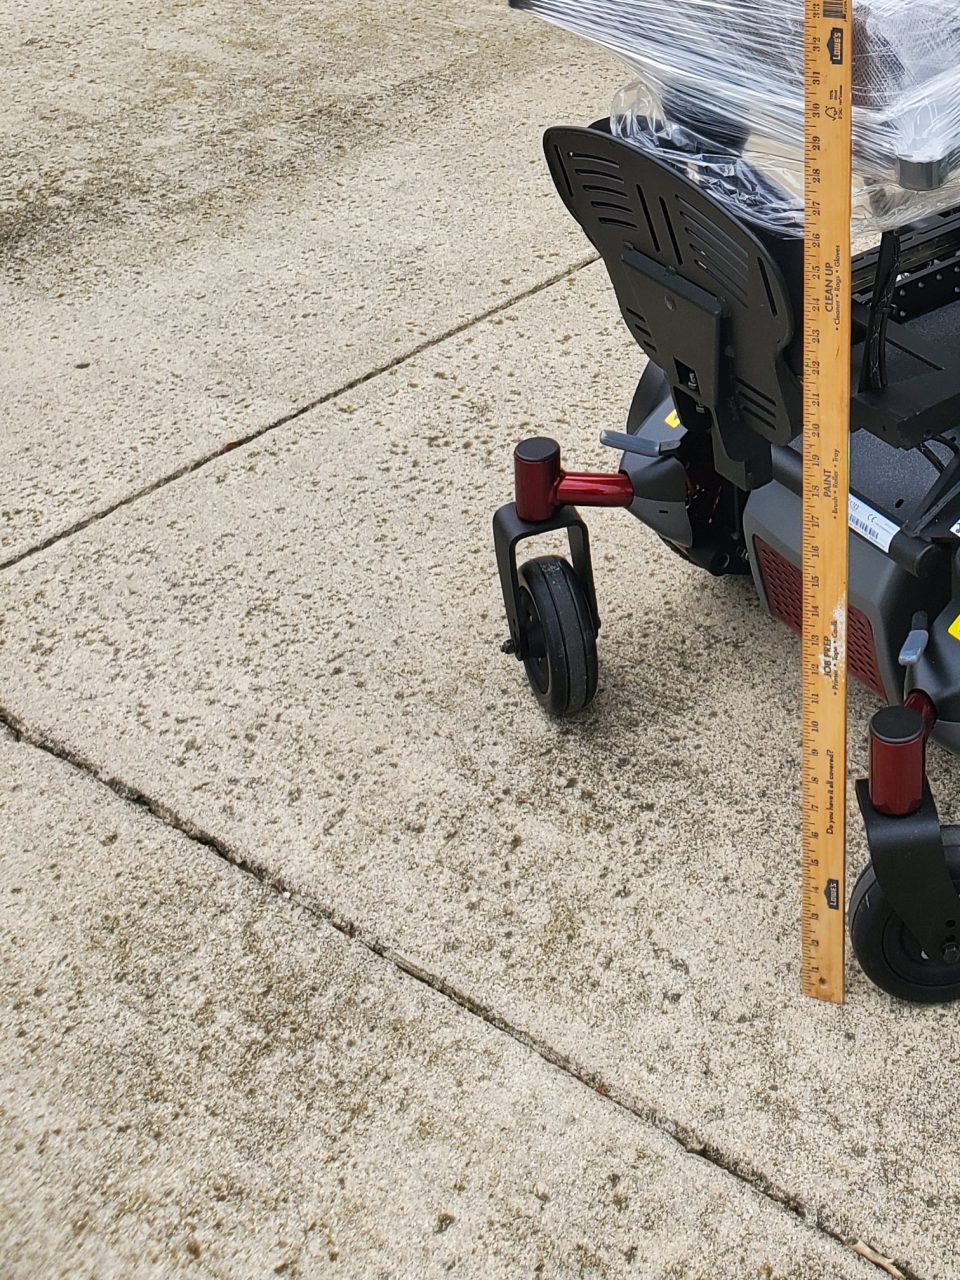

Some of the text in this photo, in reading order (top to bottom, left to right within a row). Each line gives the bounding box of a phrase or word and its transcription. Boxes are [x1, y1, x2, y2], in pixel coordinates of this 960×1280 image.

[813, 3, 820, 18] 33
[813, 37, 820, 52] 32
[813, 71, 820, 85] 31
[813, 103, 820, 118] 30
[813, 136, 820, 151] 29
[813, 169, 820, 183] 28
[812, 201, 820, 216] 27
[812, 233, 820, 248] 26
[812, 265, 820, 279] 25
[825, 262, 833, 312] CLEAN UP
[812, 298, 820, 311] 24
[812, 329, 820, 343] 23
[812, 361, 819, 375] 22
[812, 393, 819, 407] 21
[812, 424, 819, 438] 20
[812, 454, 819, 466] 19
[823, 469, 831, 497] PAINT
[812, 485, 819, 498] 18
[812, 515, 819, 528] 17
[812, 546, 819, 558] 16
[812, 576, 819, 588] 15
[812, 606, 819, 617] 14
[811, 635, 819, 646] 13
[823, 636, 832, 678] JOB PREP
[811, 664, 818, 675] 12
[811, 693, 818, 704] 11
[811, 721, 818, 732] 10
[827, 825, 833, 835] Do
